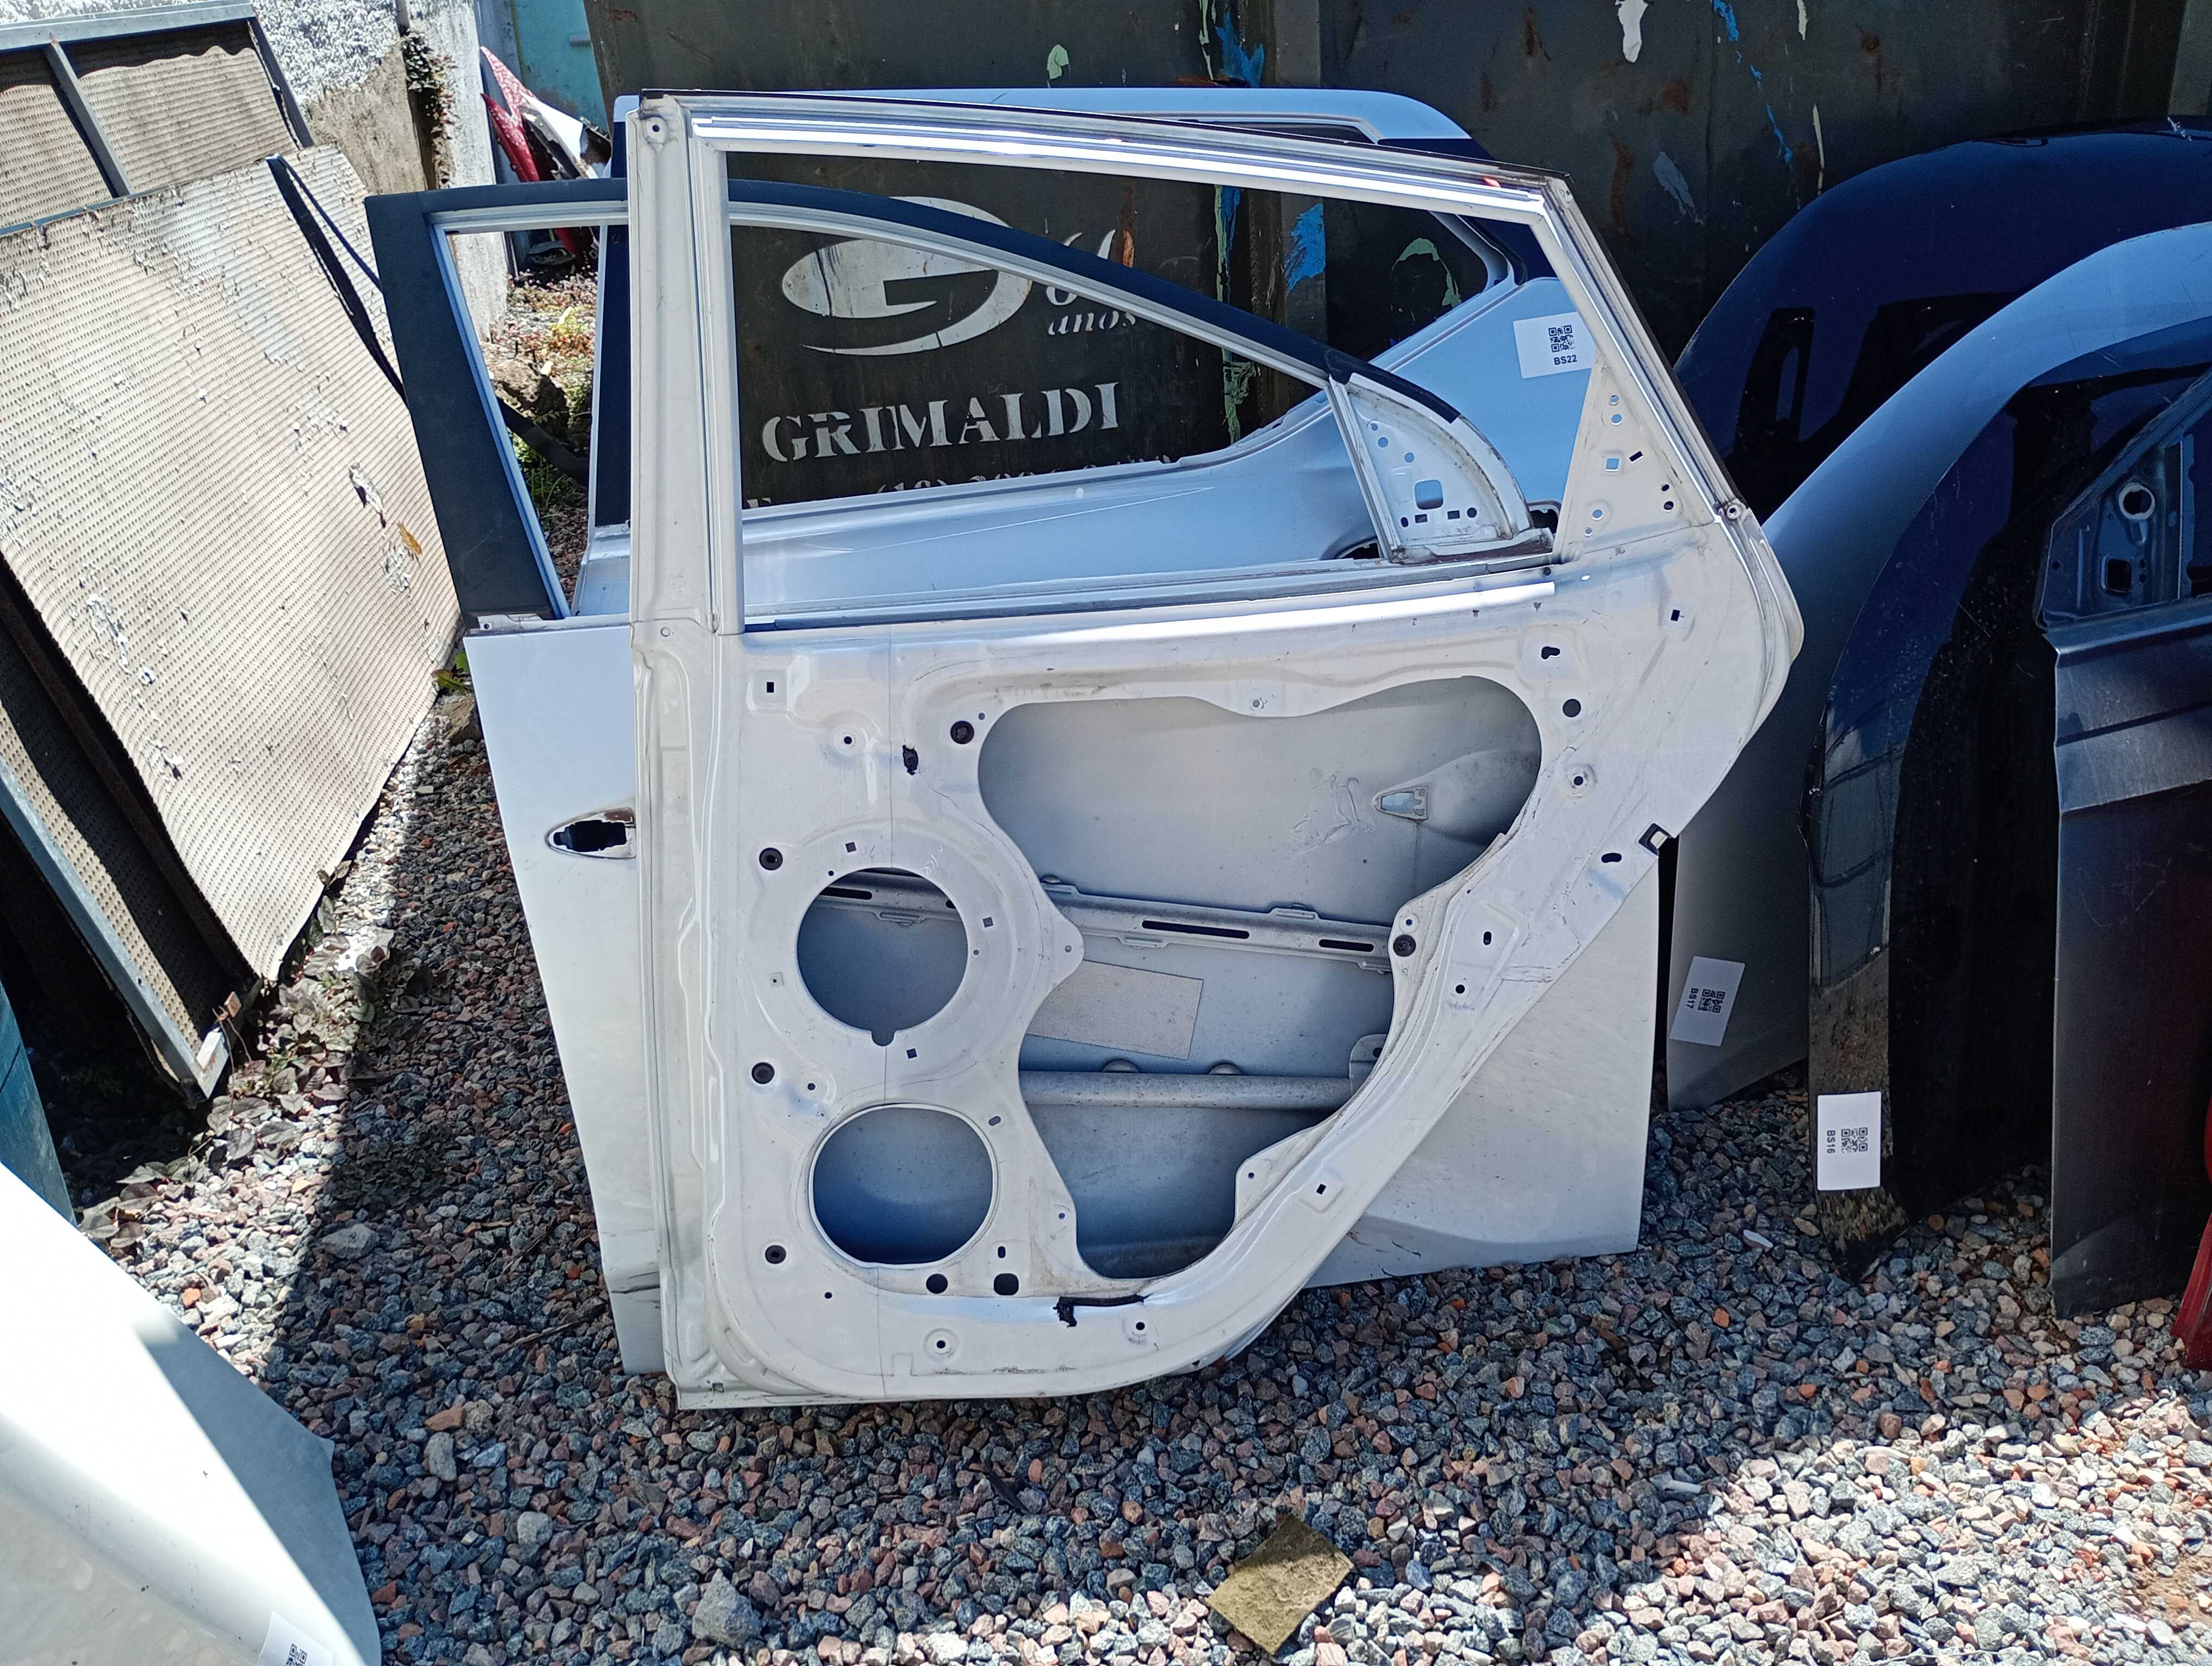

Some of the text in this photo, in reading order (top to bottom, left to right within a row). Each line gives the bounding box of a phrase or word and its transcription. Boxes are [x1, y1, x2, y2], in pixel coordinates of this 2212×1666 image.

[1554, 354, 1577, 365] BS22
[762, 382, 1119, 462] GRIMALDI
[1686, 988, 1699, 1009] BS17
[1827, 1130, 1836, 1154] BS16
